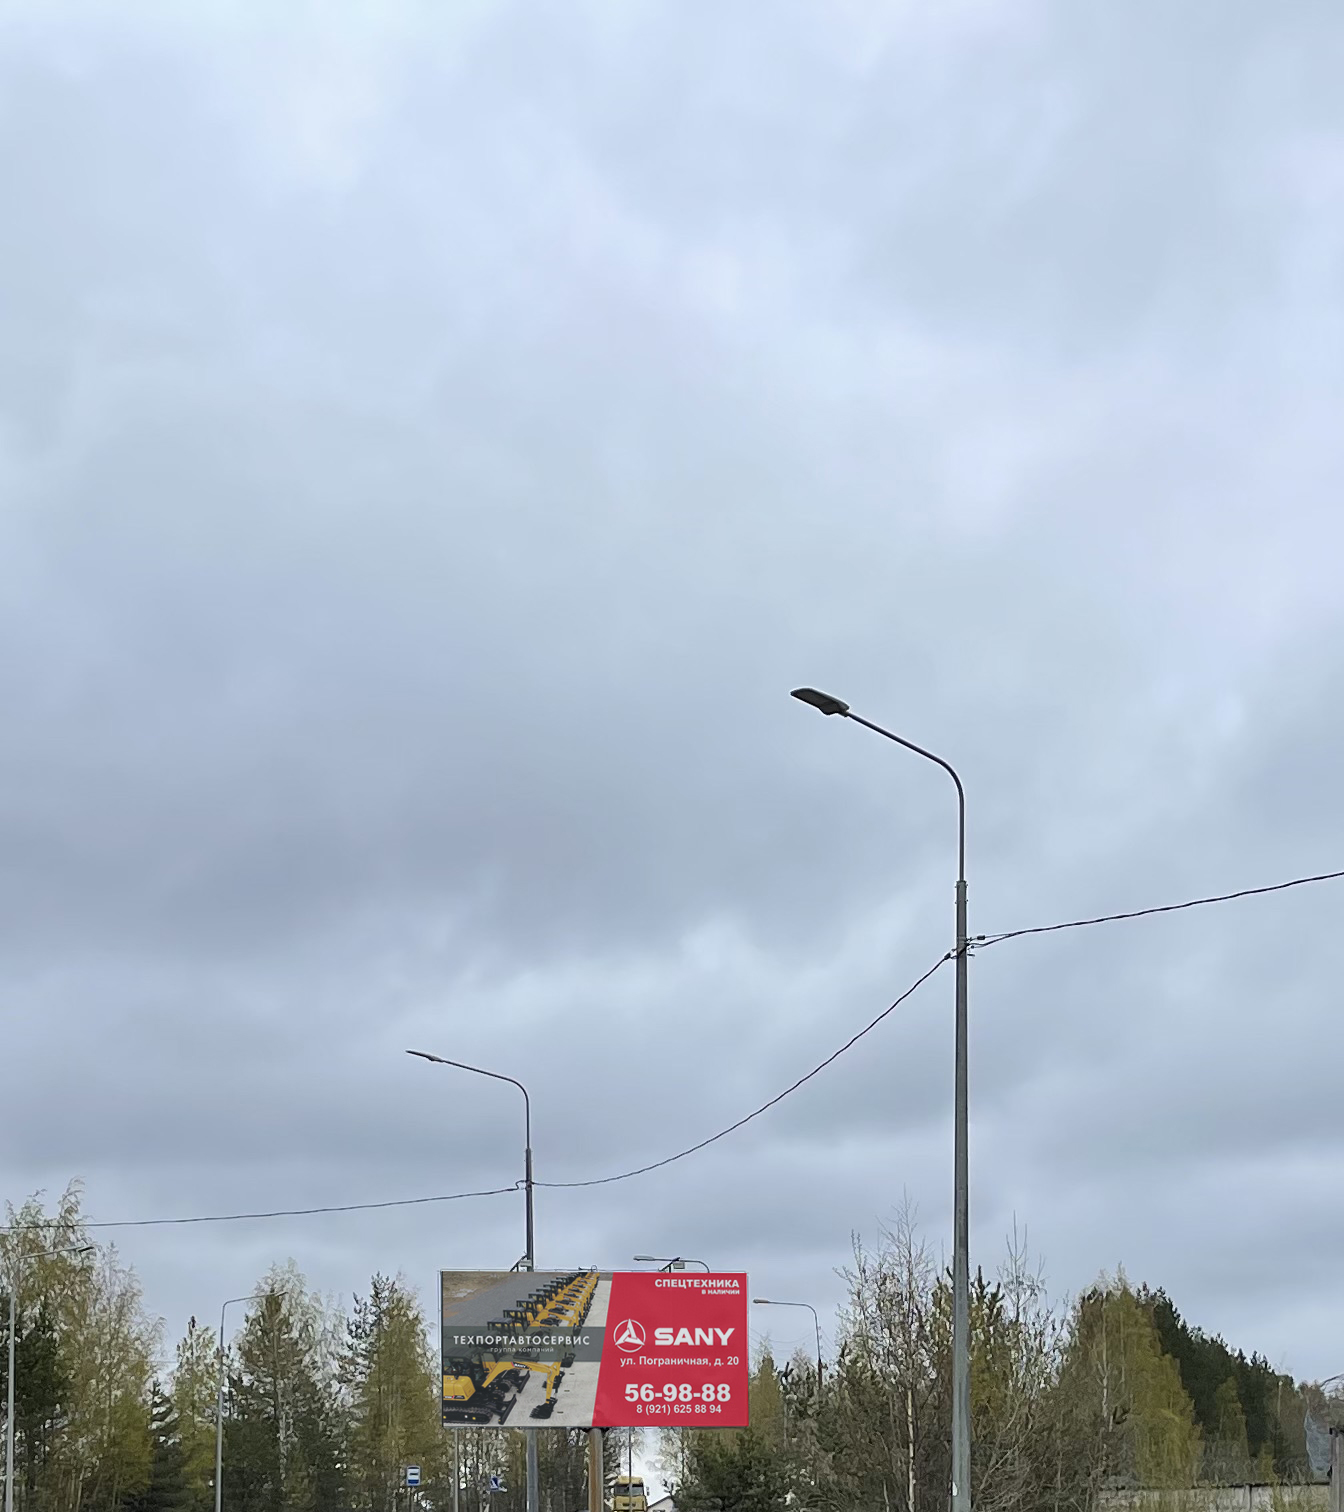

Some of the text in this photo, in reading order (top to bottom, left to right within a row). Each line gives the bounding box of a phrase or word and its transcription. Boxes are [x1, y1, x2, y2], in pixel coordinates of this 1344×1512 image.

[654, 1279, 740, 1289] СПЕЦТЕХНИКА
[453, 1335, 590, 1345] ТЕХПОРТАВТОСЕРВИС
[654, 1327, 736, 1346] SANY
[620, 1356, 739, 1367] ул. Пограничная, д. 20
[624, 1383, 731, 1402] 56-98-88
[636, 1404, 722, 1415] 8 (921) 625 88 94
